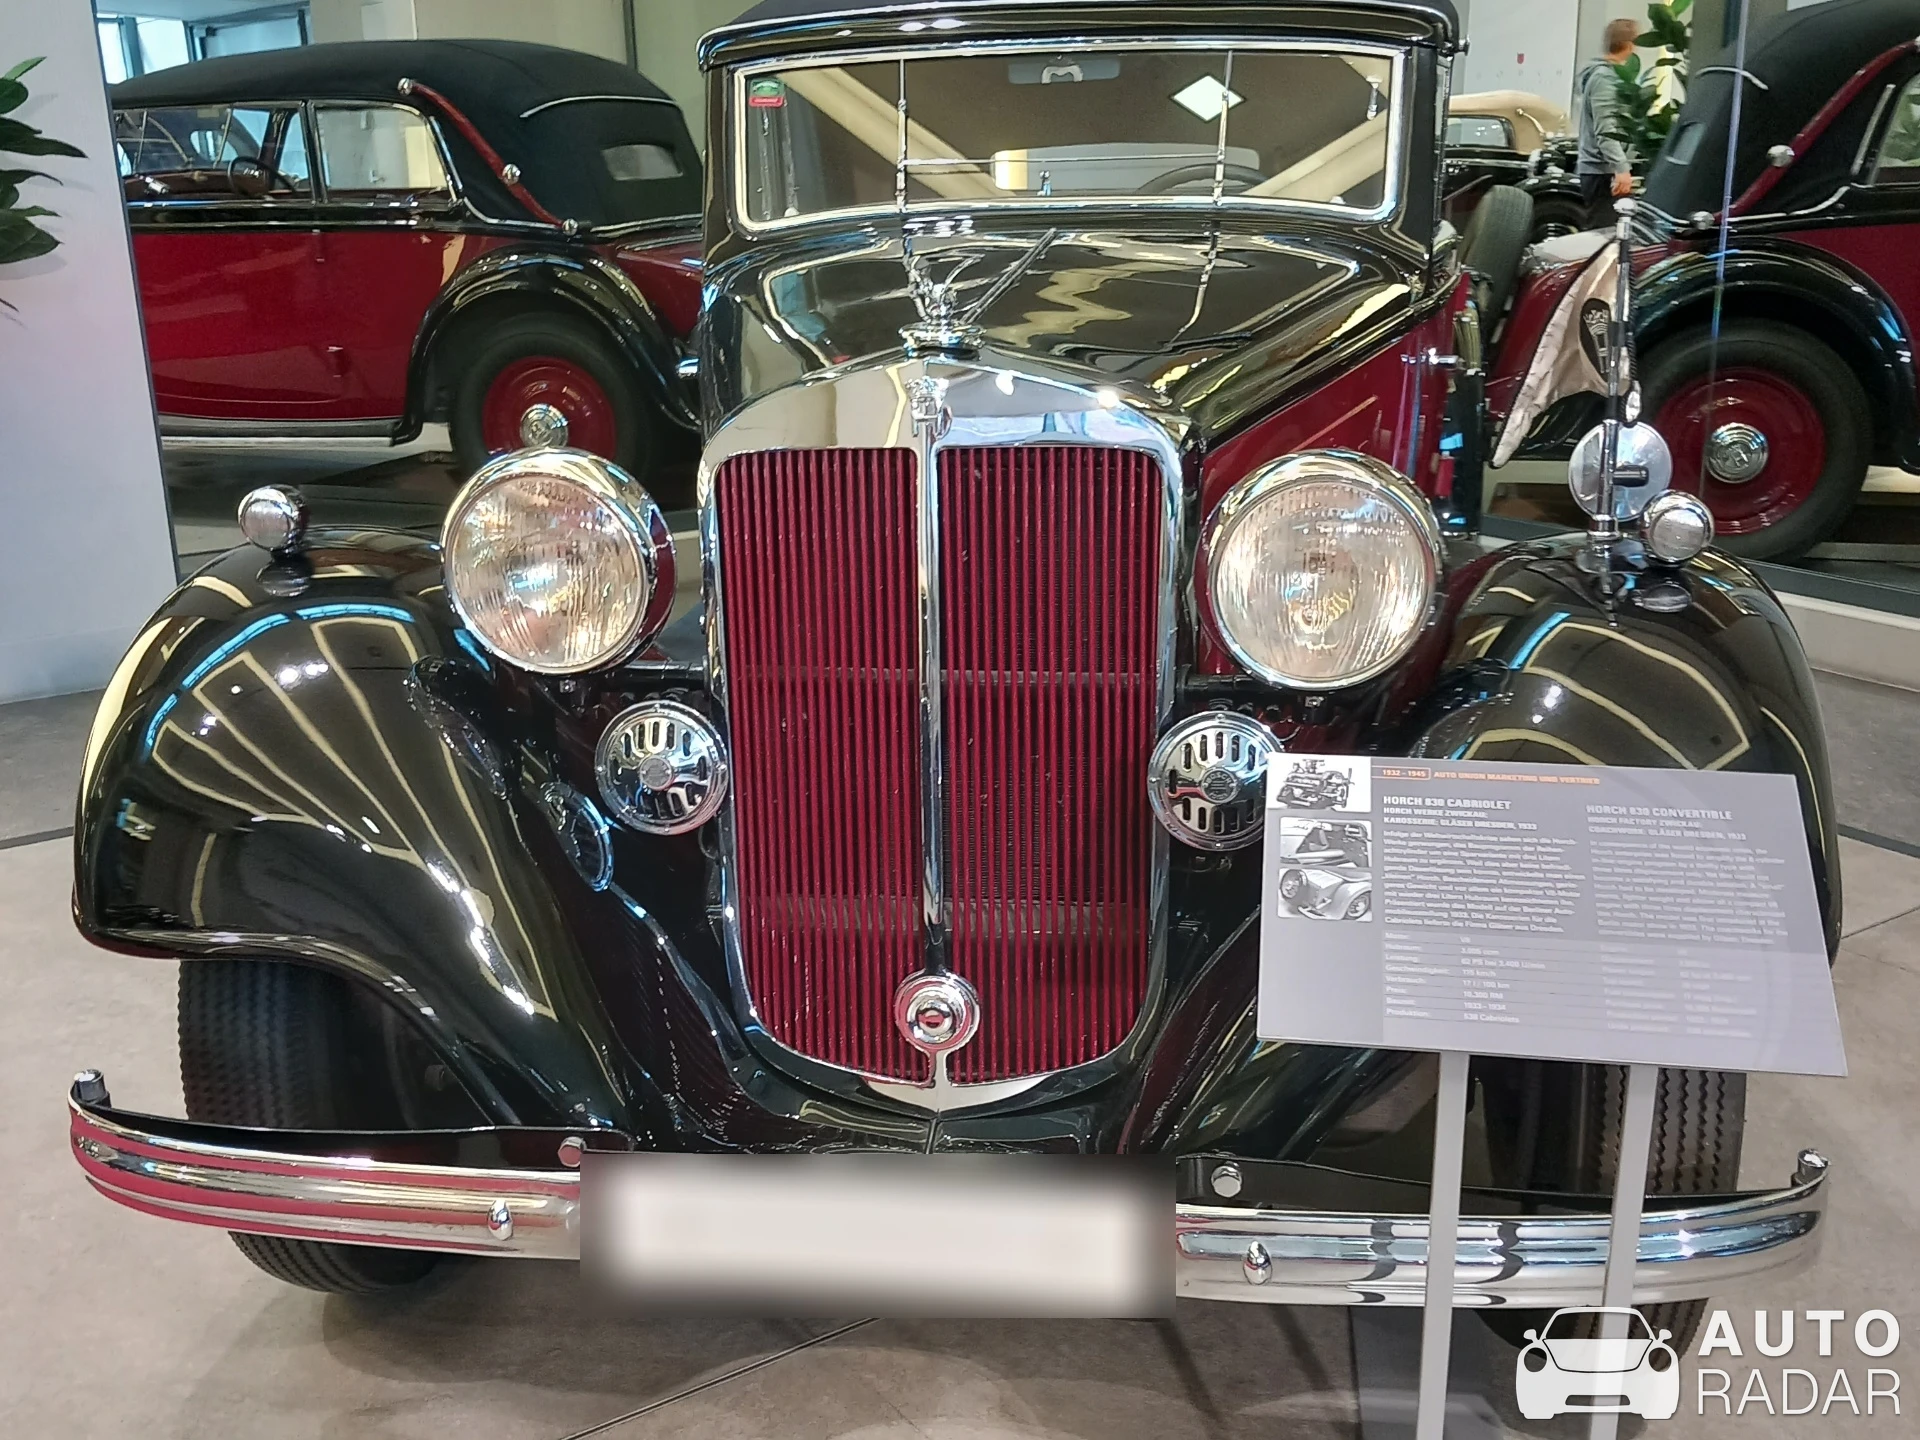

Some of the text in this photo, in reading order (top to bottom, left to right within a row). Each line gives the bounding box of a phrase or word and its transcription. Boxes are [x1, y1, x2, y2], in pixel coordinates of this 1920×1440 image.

[1205, 771, 1232, 784] BOSCH
[1382, 769, 1401, 777] 1932
[1407, 770, 1426, 778] 1945
[1433, 771, 1457, 779] AUTO
[1383, 796, 1511, 810] HORCH 830 CABRIOLET
[1383, 807, 1412, 815] HORCH
[1586, 804, 1733, 820] HORCH 830 CONVERTIBLE
